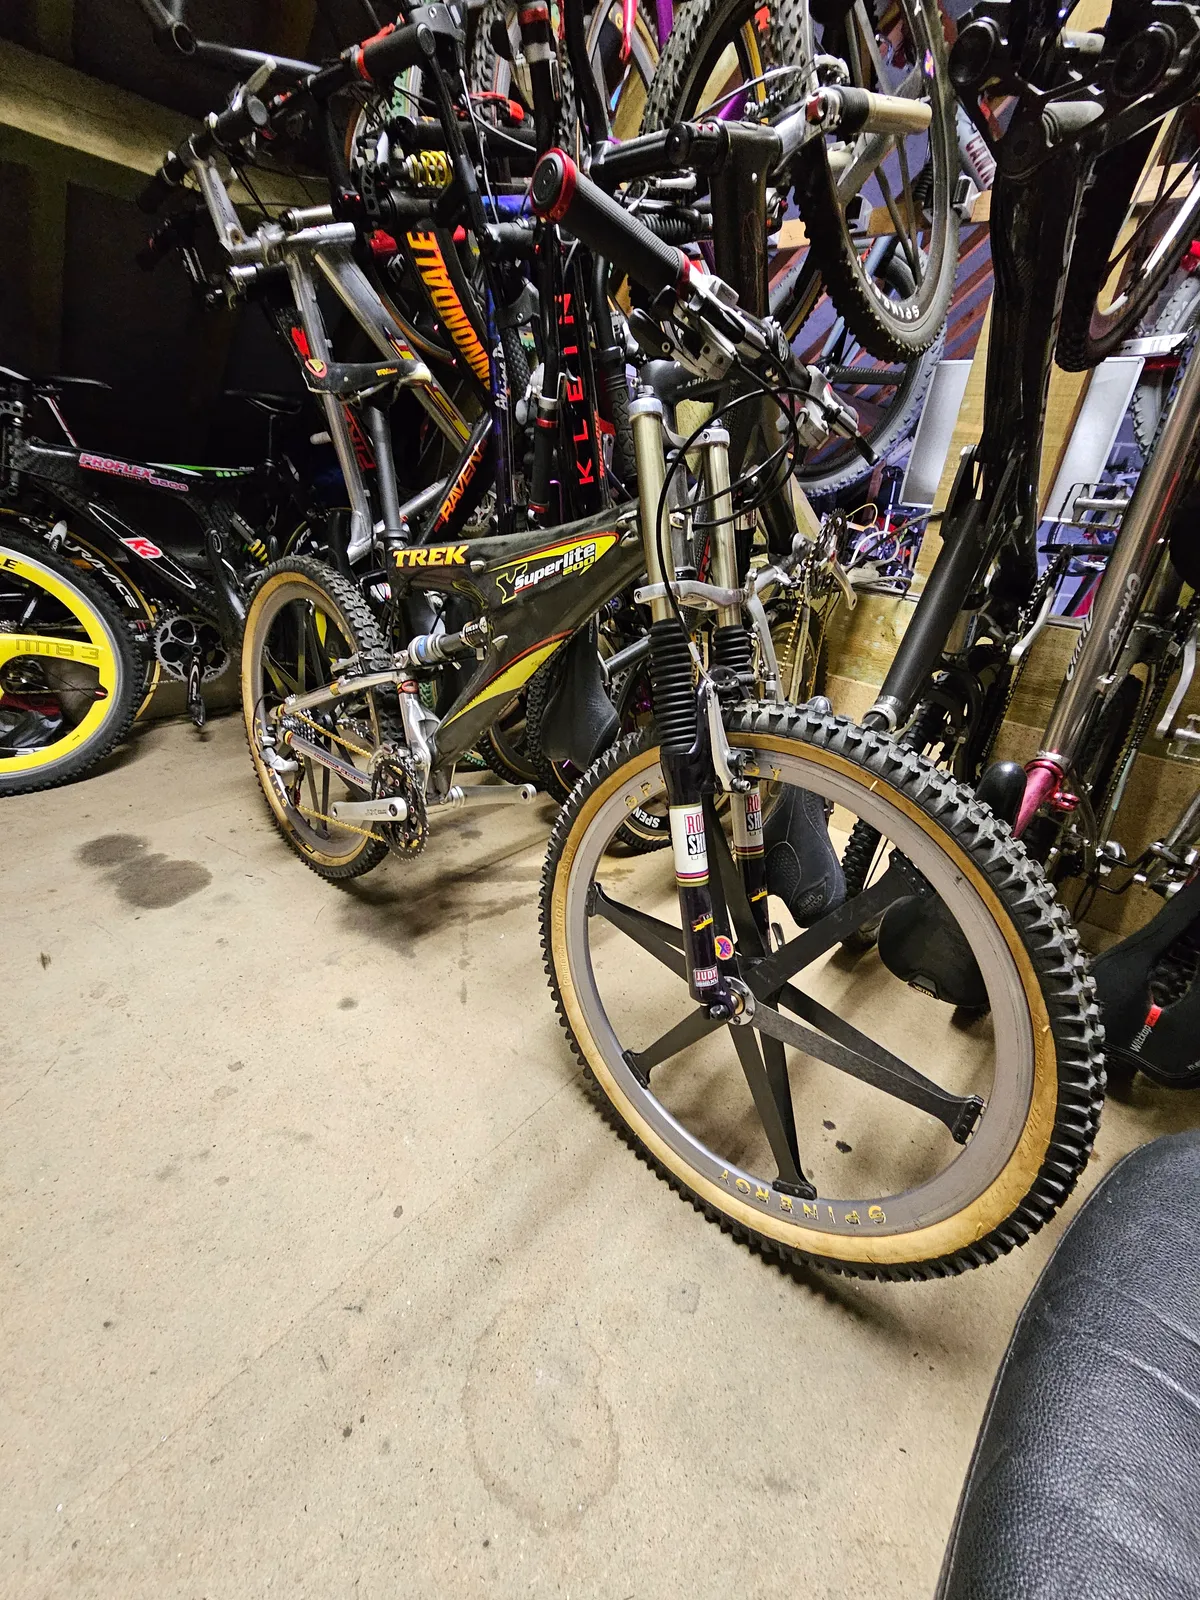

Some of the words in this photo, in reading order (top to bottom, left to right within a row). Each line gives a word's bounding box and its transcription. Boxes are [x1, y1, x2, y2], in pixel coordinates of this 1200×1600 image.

[554, 293, 595, 486] KLEIN
[79, 453, 155, 479] PROFLEX
[440, 443, 484, 522] RAVEN
[120, 537, 163, 559] K2
[393, 544, 469, 568] TREK
[63, 541, 140, 610] URA-ACE
[562, 556, 595, 576] 200
[747, 794, 761, 813] RO
[747, 812, 763, 831] SH
[688, 834, 707, 856] SH
[696, 969, 717, 981] JUDY
[1130, 1024, 1152, 1053] Wittkop
[718, 1169, 887, 1226] SPINERGY
